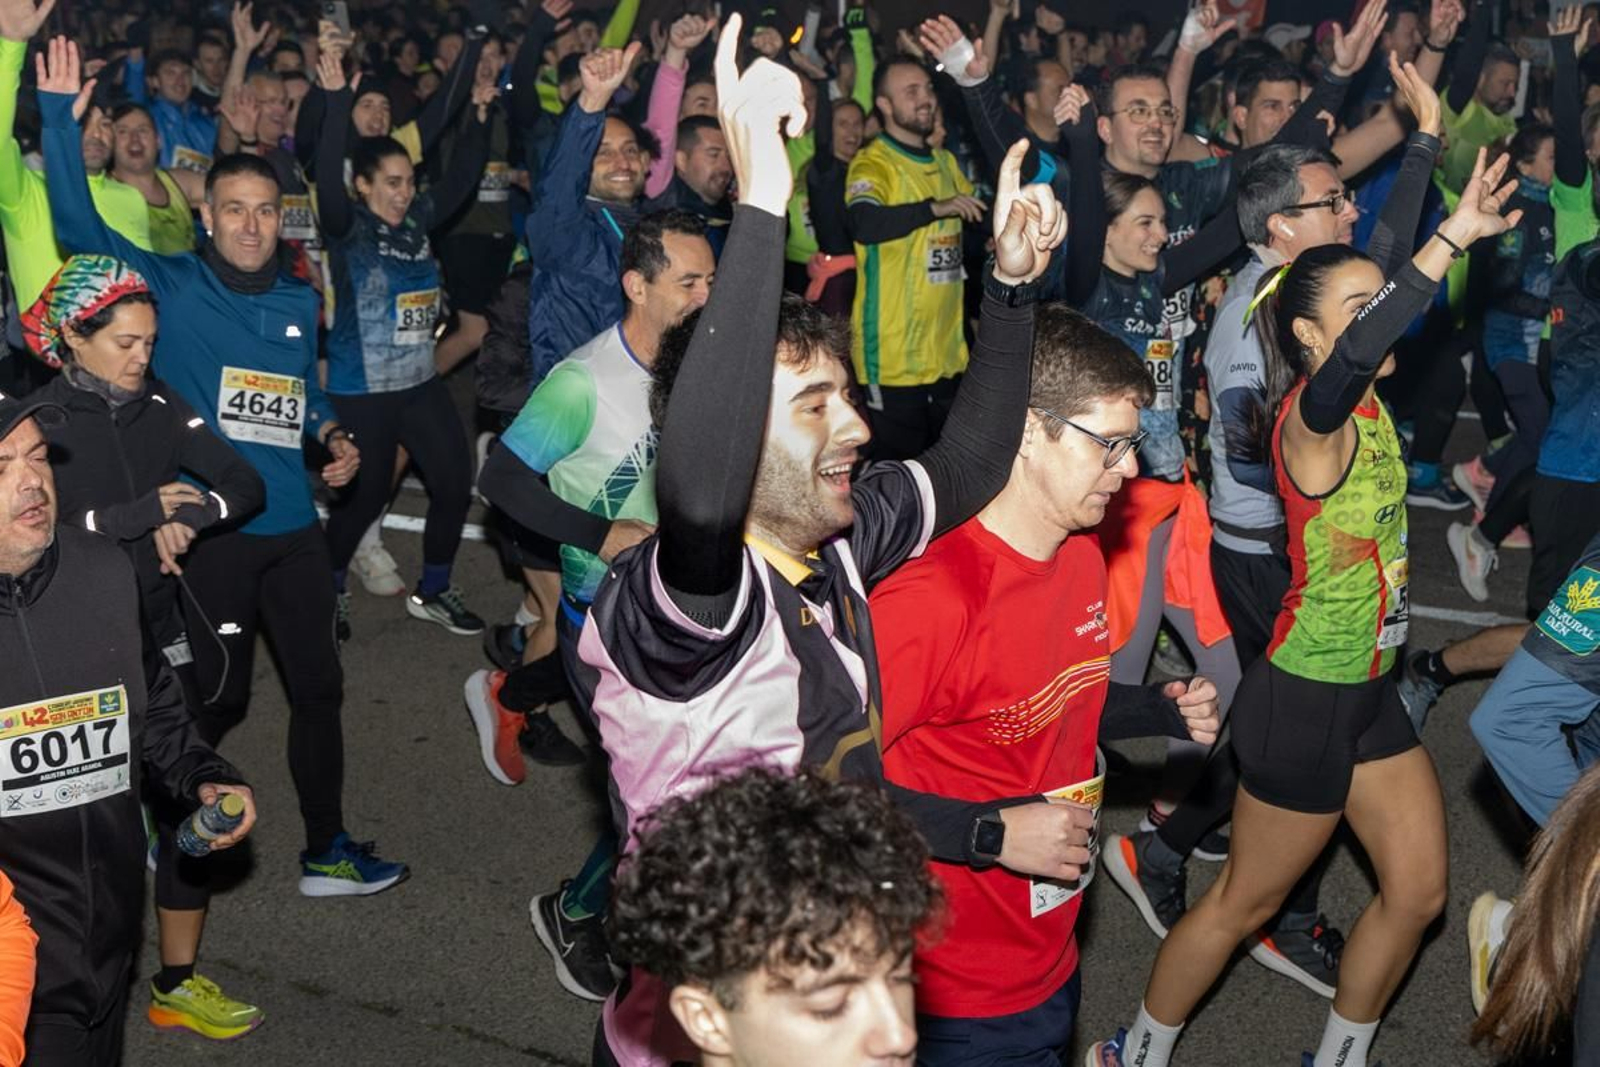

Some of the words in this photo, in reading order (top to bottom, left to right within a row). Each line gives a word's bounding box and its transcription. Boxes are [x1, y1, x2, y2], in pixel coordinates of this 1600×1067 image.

[1357, 281, 1397, 321] KIPRUN
[1230, 362, 1257, 373] DAVID
[228, 390, 299, 421] 4643
[1560, 612, 1595, 641] RURAL
[21, 706, 50, 728] 42
[10, 718, 118, 775] 6017
[1334, 1035, 1356, 1067] ALOMON
